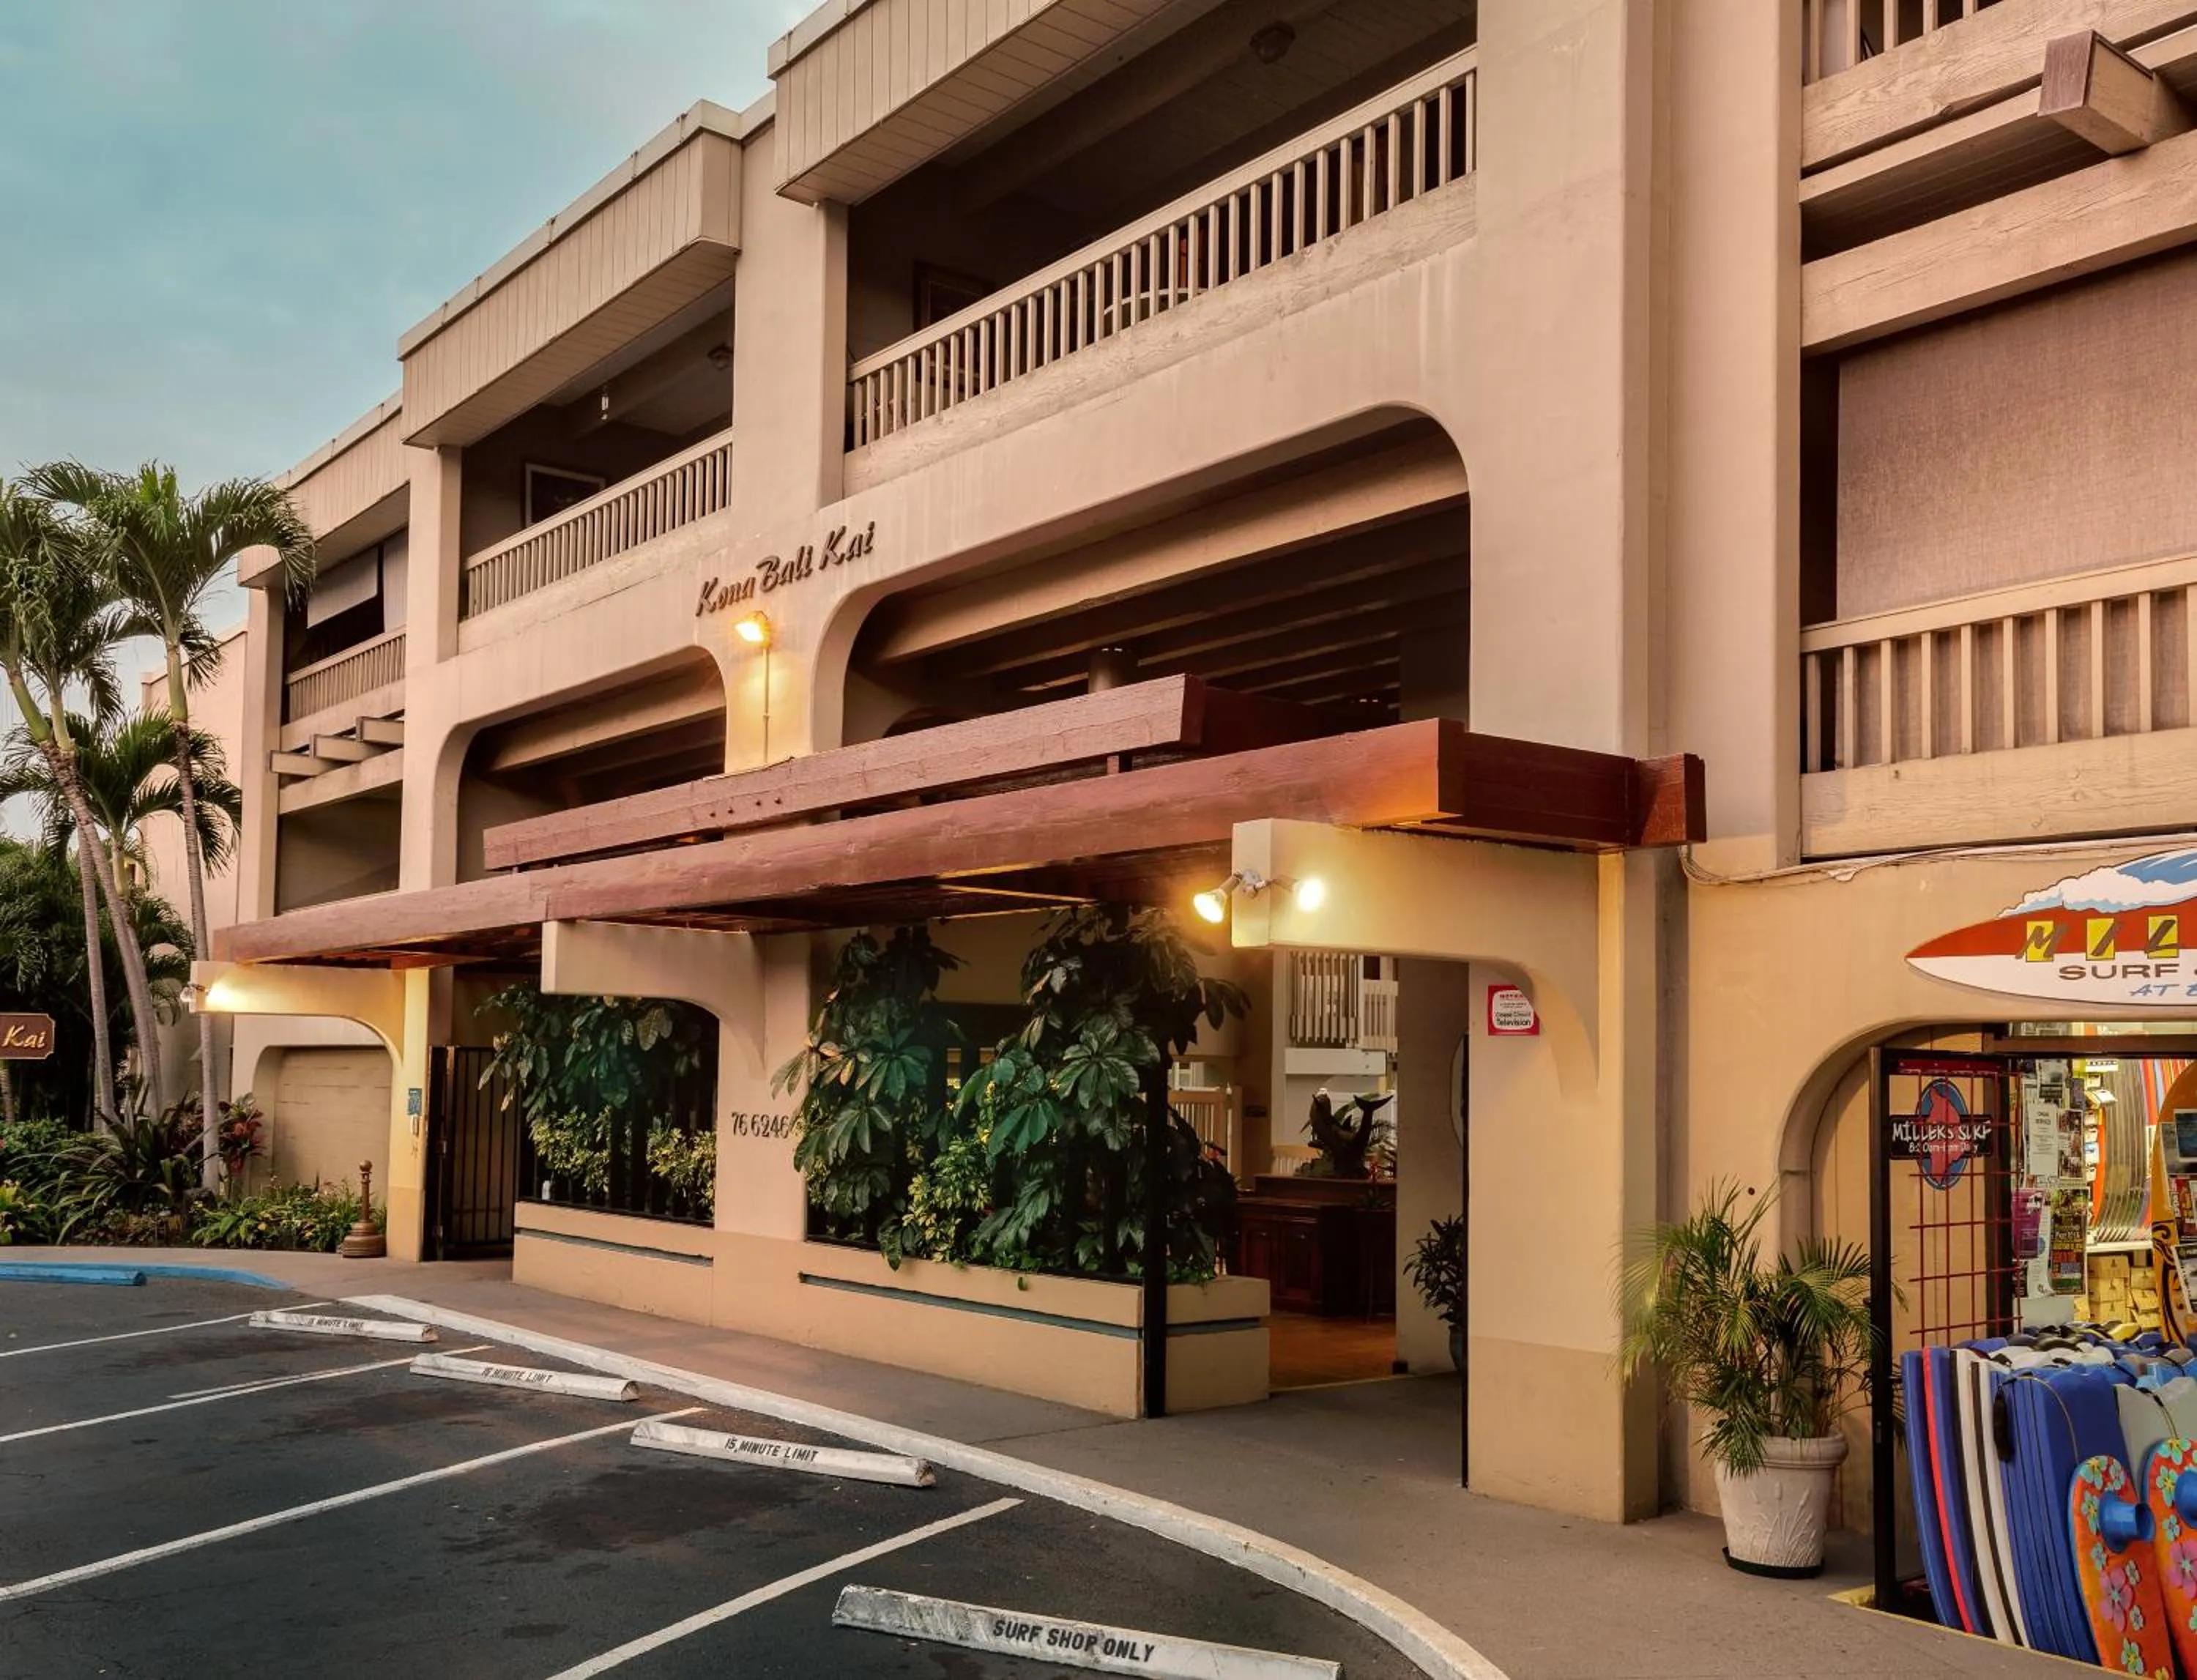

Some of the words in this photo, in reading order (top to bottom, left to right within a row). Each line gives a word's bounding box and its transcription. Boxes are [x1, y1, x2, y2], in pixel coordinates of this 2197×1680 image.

[696, 577, 756, 617] Kona
[756, 546, 814, 592] Bali
[818, 521, 875, 570] Kai
[2059, 963, 2180, 980] SURF
[2130, 984, 2179, 997] AT
[1, 1025, 46, 1048] Kai
[493, 1368, 525, 1381] MINUTE
[527, 1370, 553, 1383] LIMIT
[738, 1441, 781, 1457] MINUTE
[784, 1446, 819, 1462] LIMIT
[993, 1620, 1043, 1643] SURF
[1047, 1628, 1097, 1652] SHOP
[1102, 1638, 1155, 1663] ONLY
